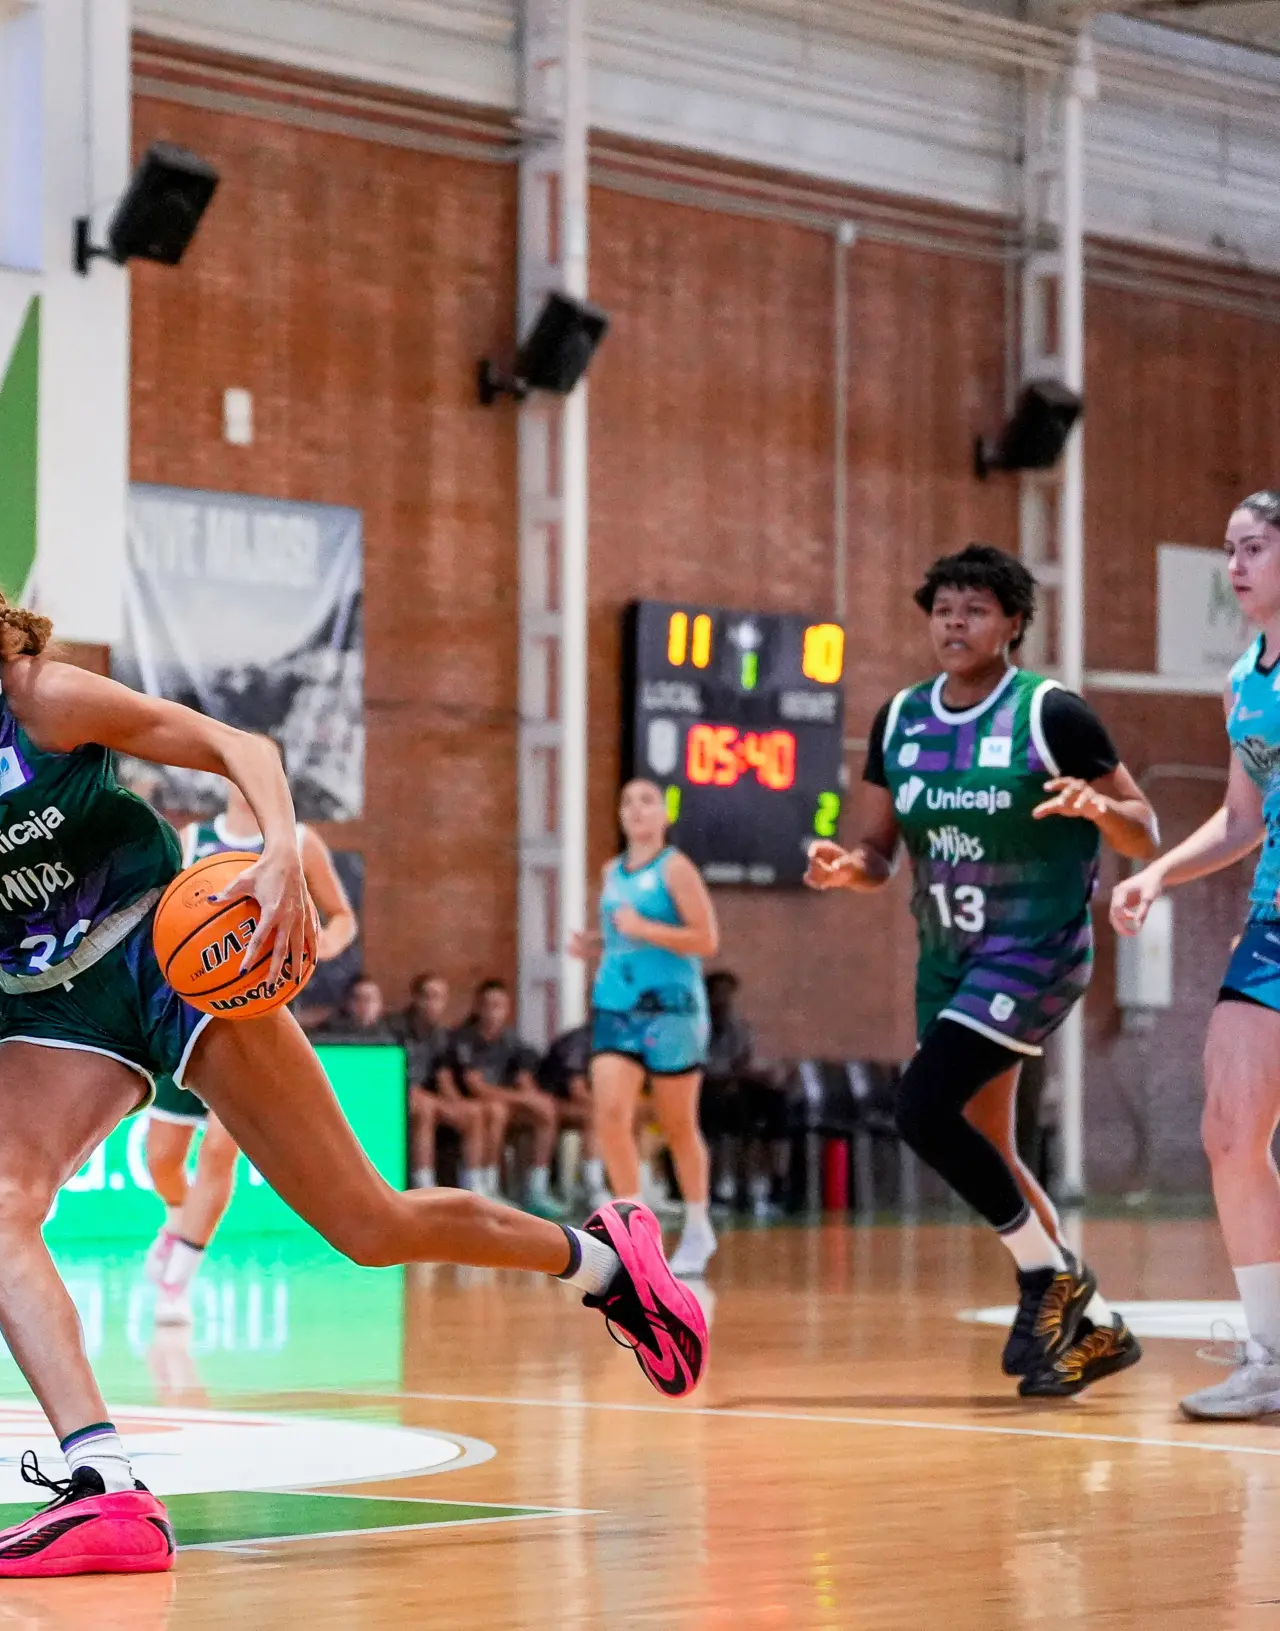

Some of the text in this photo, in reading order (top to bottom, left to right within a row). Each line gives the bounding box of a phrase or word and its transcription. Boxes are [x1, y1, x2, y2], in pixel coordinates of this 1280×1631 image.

[668, 611, 846, 685] 11 0
[740, 651, 759, 691] 1
[686, 723, 796, 791] 05:40
[814, 791, 841, 837] 2
[926, 784, 1012, 815] Unicaja
[927, 826, 985, 867] Mijas
[928, 882, 987, 933] 13
